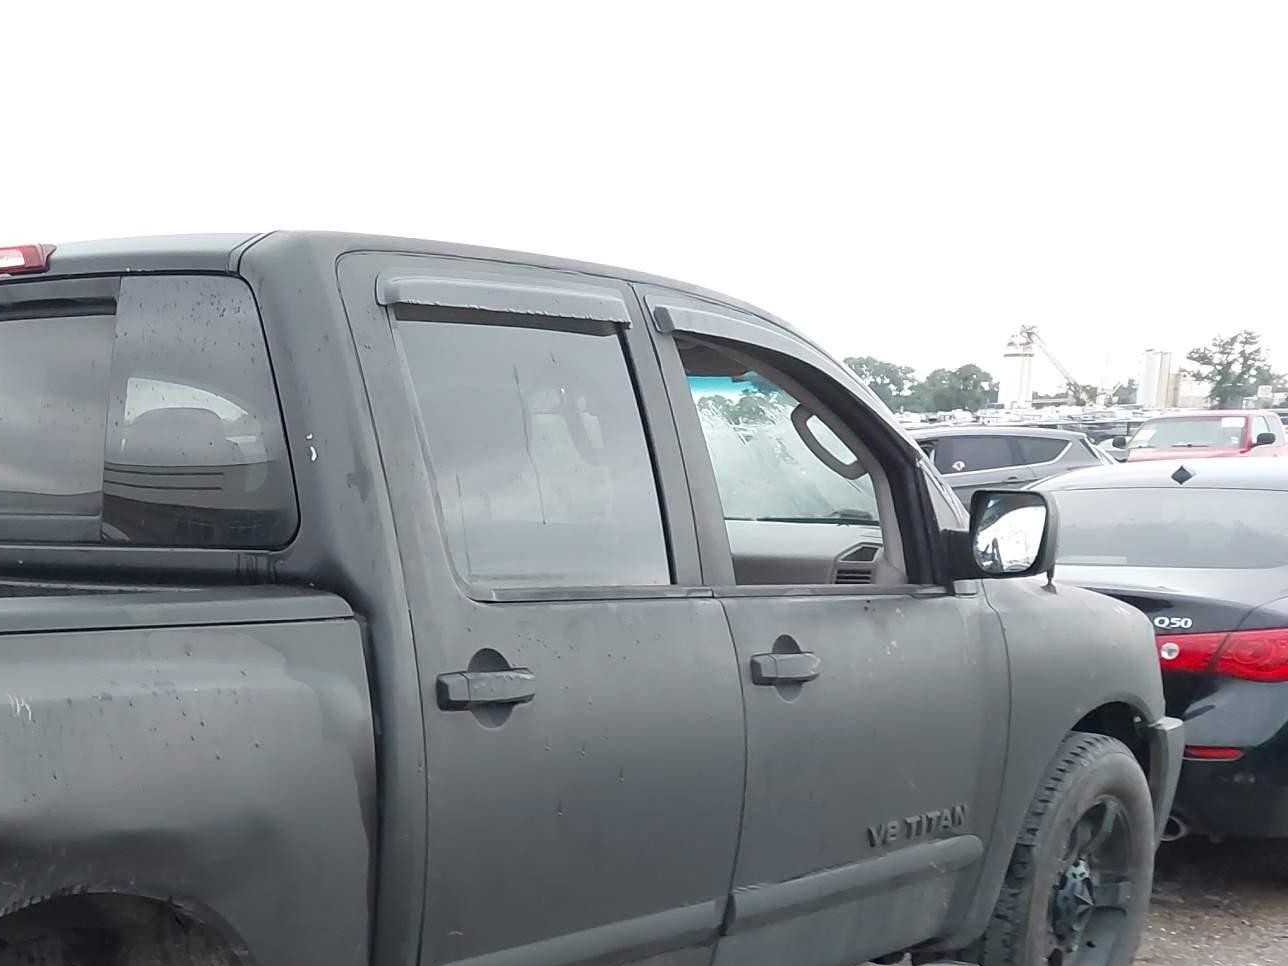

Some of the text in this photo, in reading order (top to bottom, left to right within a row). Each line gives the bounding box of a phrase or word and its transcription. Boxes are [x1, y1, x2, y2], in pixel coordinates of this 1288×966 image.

[1153, 616, 1193, 629] Q50
[866, 804, 969, 848] V8 TITAN
